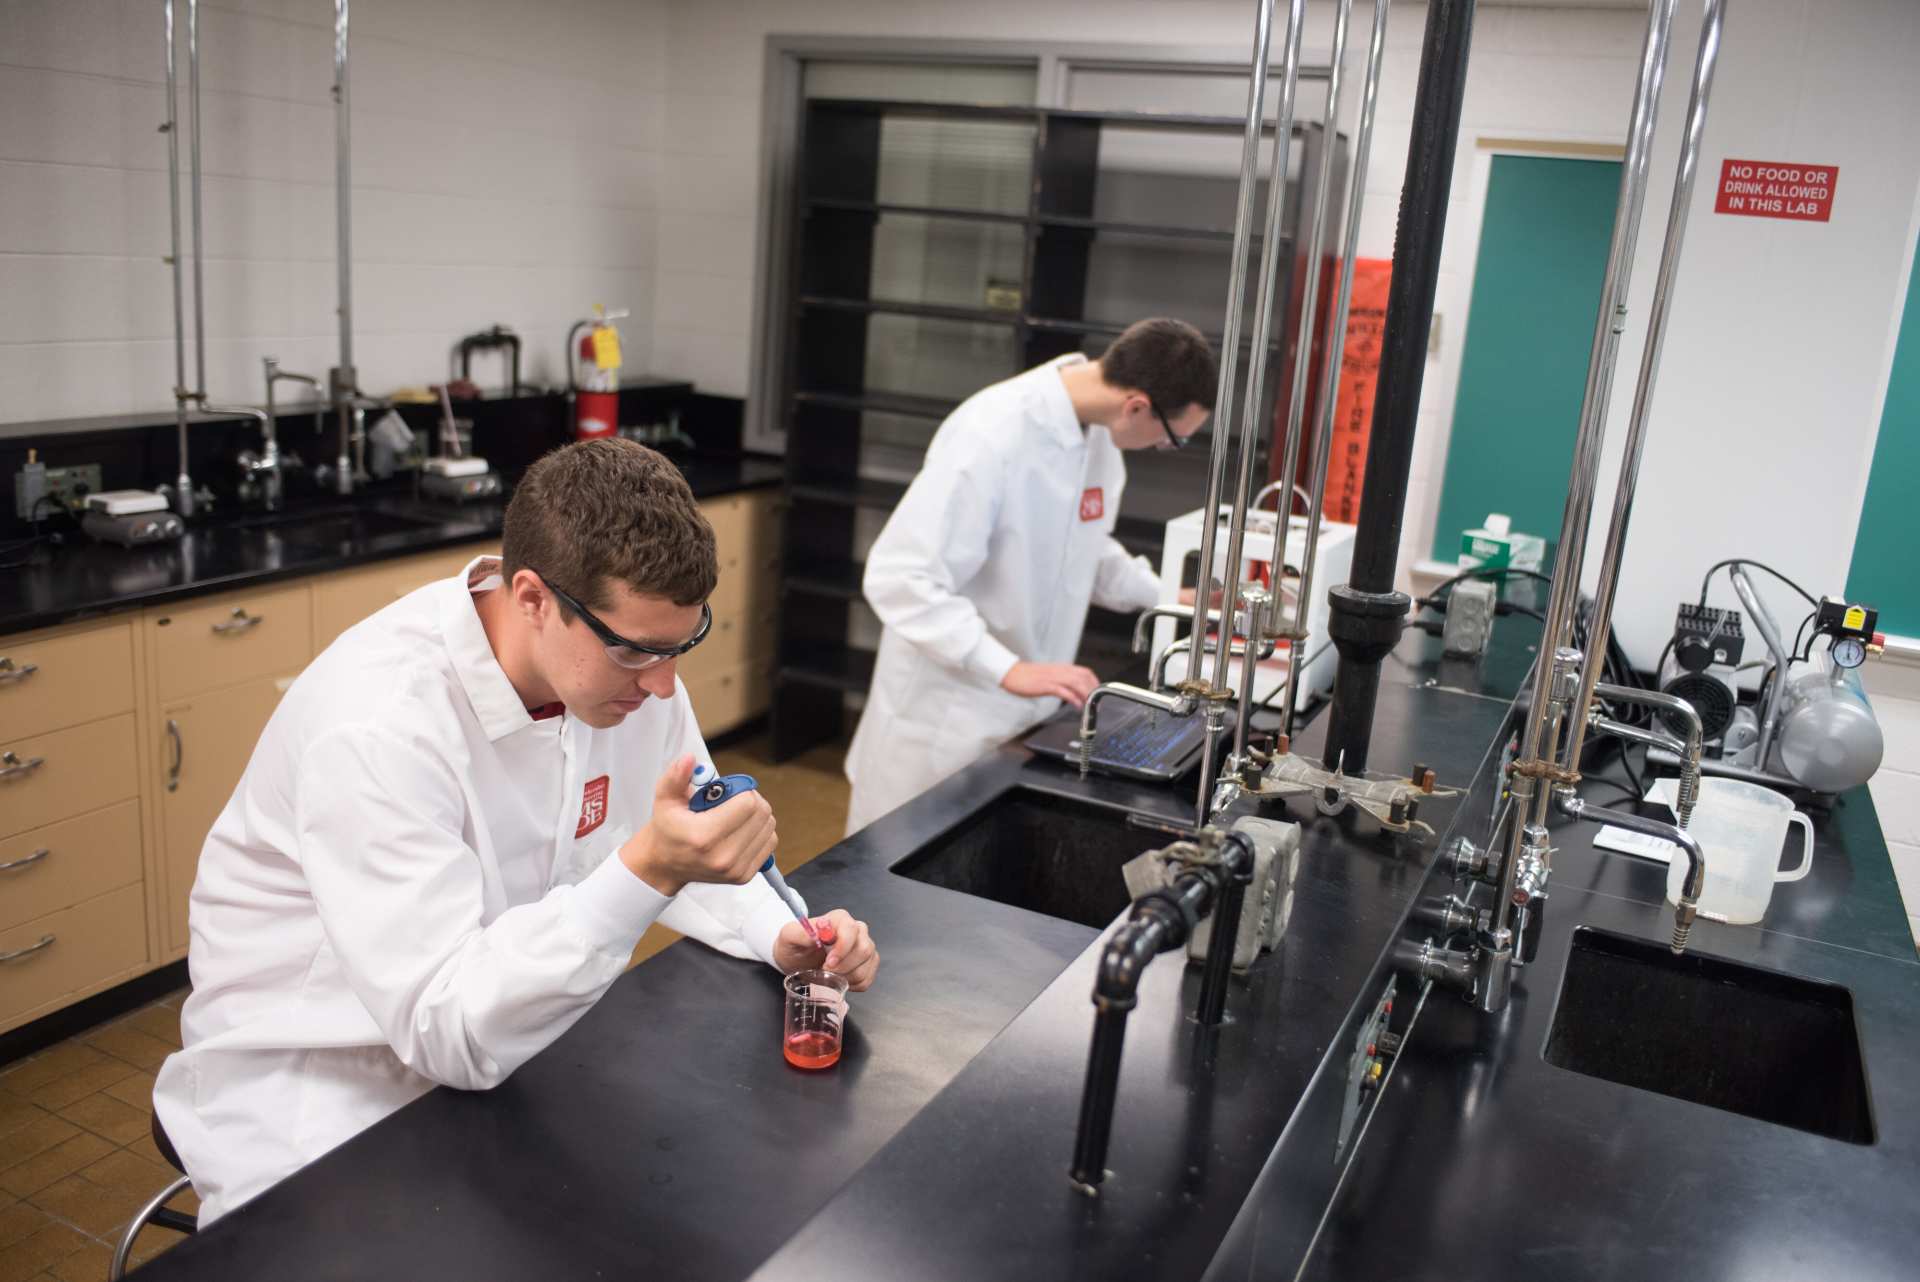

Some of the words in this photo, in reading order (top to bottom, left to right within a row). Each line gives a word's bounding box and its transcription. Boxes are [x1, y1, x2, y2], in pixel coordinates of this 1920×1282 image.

[1730, 166, 1752, 178] NO
[1756, 167, 1800, 182] FOOD
[1804, 171, 1828, 184] OR
[1725, 180, 1763, 195] DRINK
[1765, 185, 1828, 200] ALLOWED
[1728, 196, 1744, 209] IN
[1749, 198, 1782, 212] THIS
[1786, 202, 1817, 215] LAB
